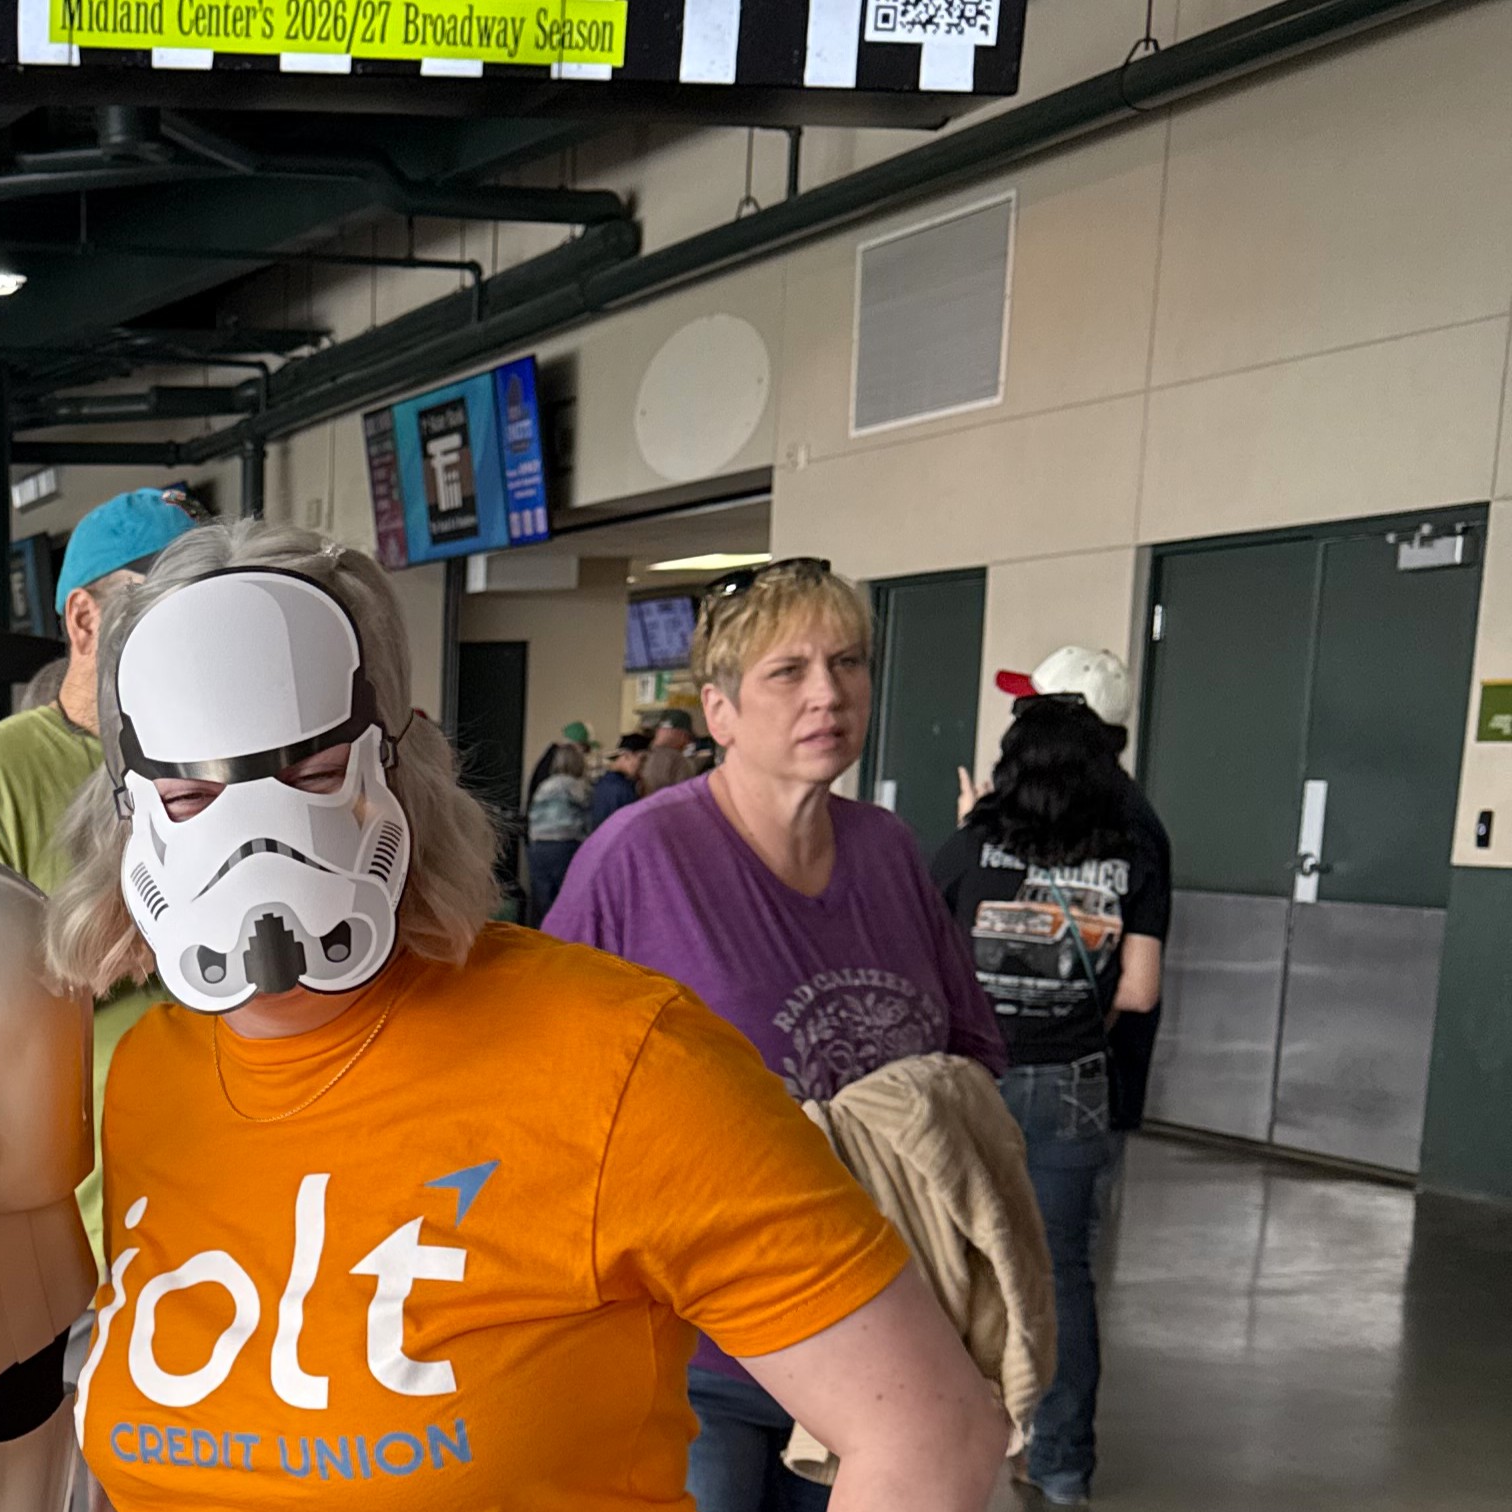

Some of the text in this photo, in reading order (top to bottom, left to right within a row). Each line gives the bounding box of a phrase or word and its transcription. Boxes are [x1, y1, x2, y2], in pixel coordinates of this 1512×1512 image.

[60, 0, 614, 58] Midland Center's 2026/27 Broadway Season
[74, 1173, 467, 1450] jolt
[110, 1418, 473, 1480] CREDIT UNION
